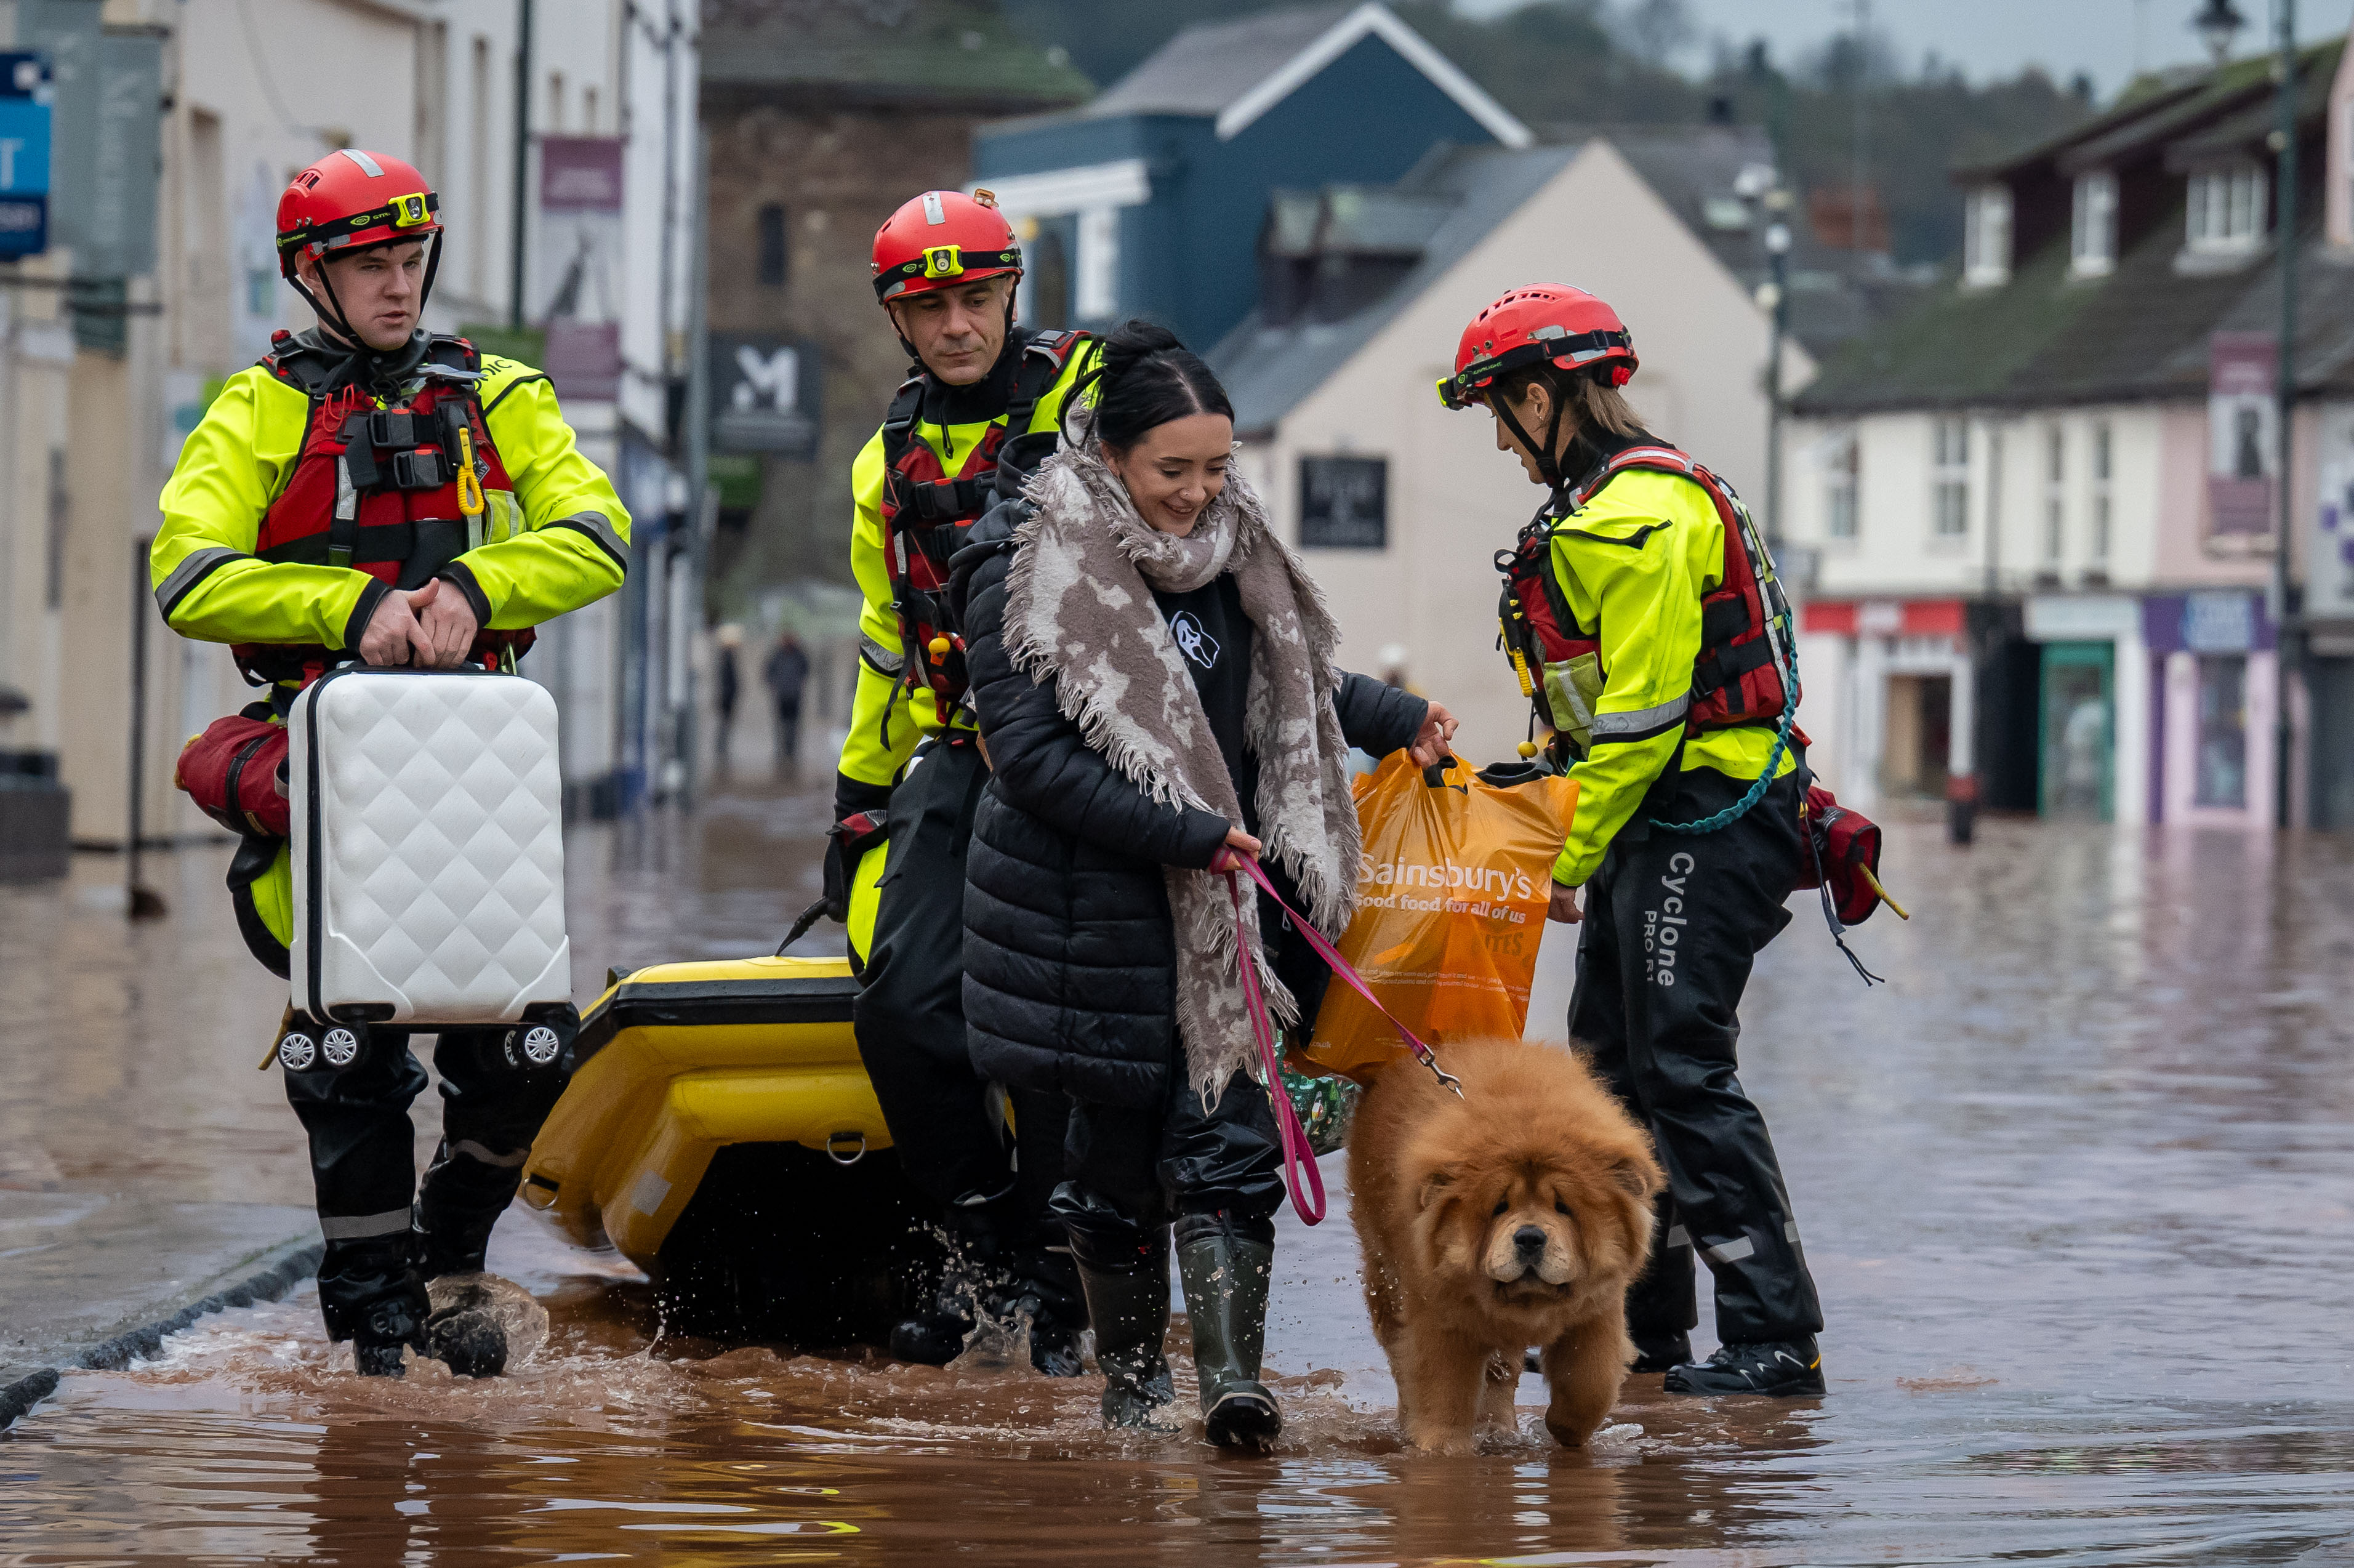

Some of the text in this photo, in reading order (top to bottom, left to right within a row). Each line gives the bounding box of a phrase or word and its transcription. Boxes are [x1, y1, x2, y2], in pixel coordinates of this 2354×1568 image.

[1357, 853, 1532, 903] Sainsbury's
[1400, 894, 1442, 912] food
[1445, 896, 1470, 914] for
[1471, 901, 1492, 917] all
[1492, 905, 1510, 920] of
[1509, 910, 1527, 924] us
[1657, 852, 1695, 986] Cyclone
[1644, 911, 1658, 982] PRO R1
